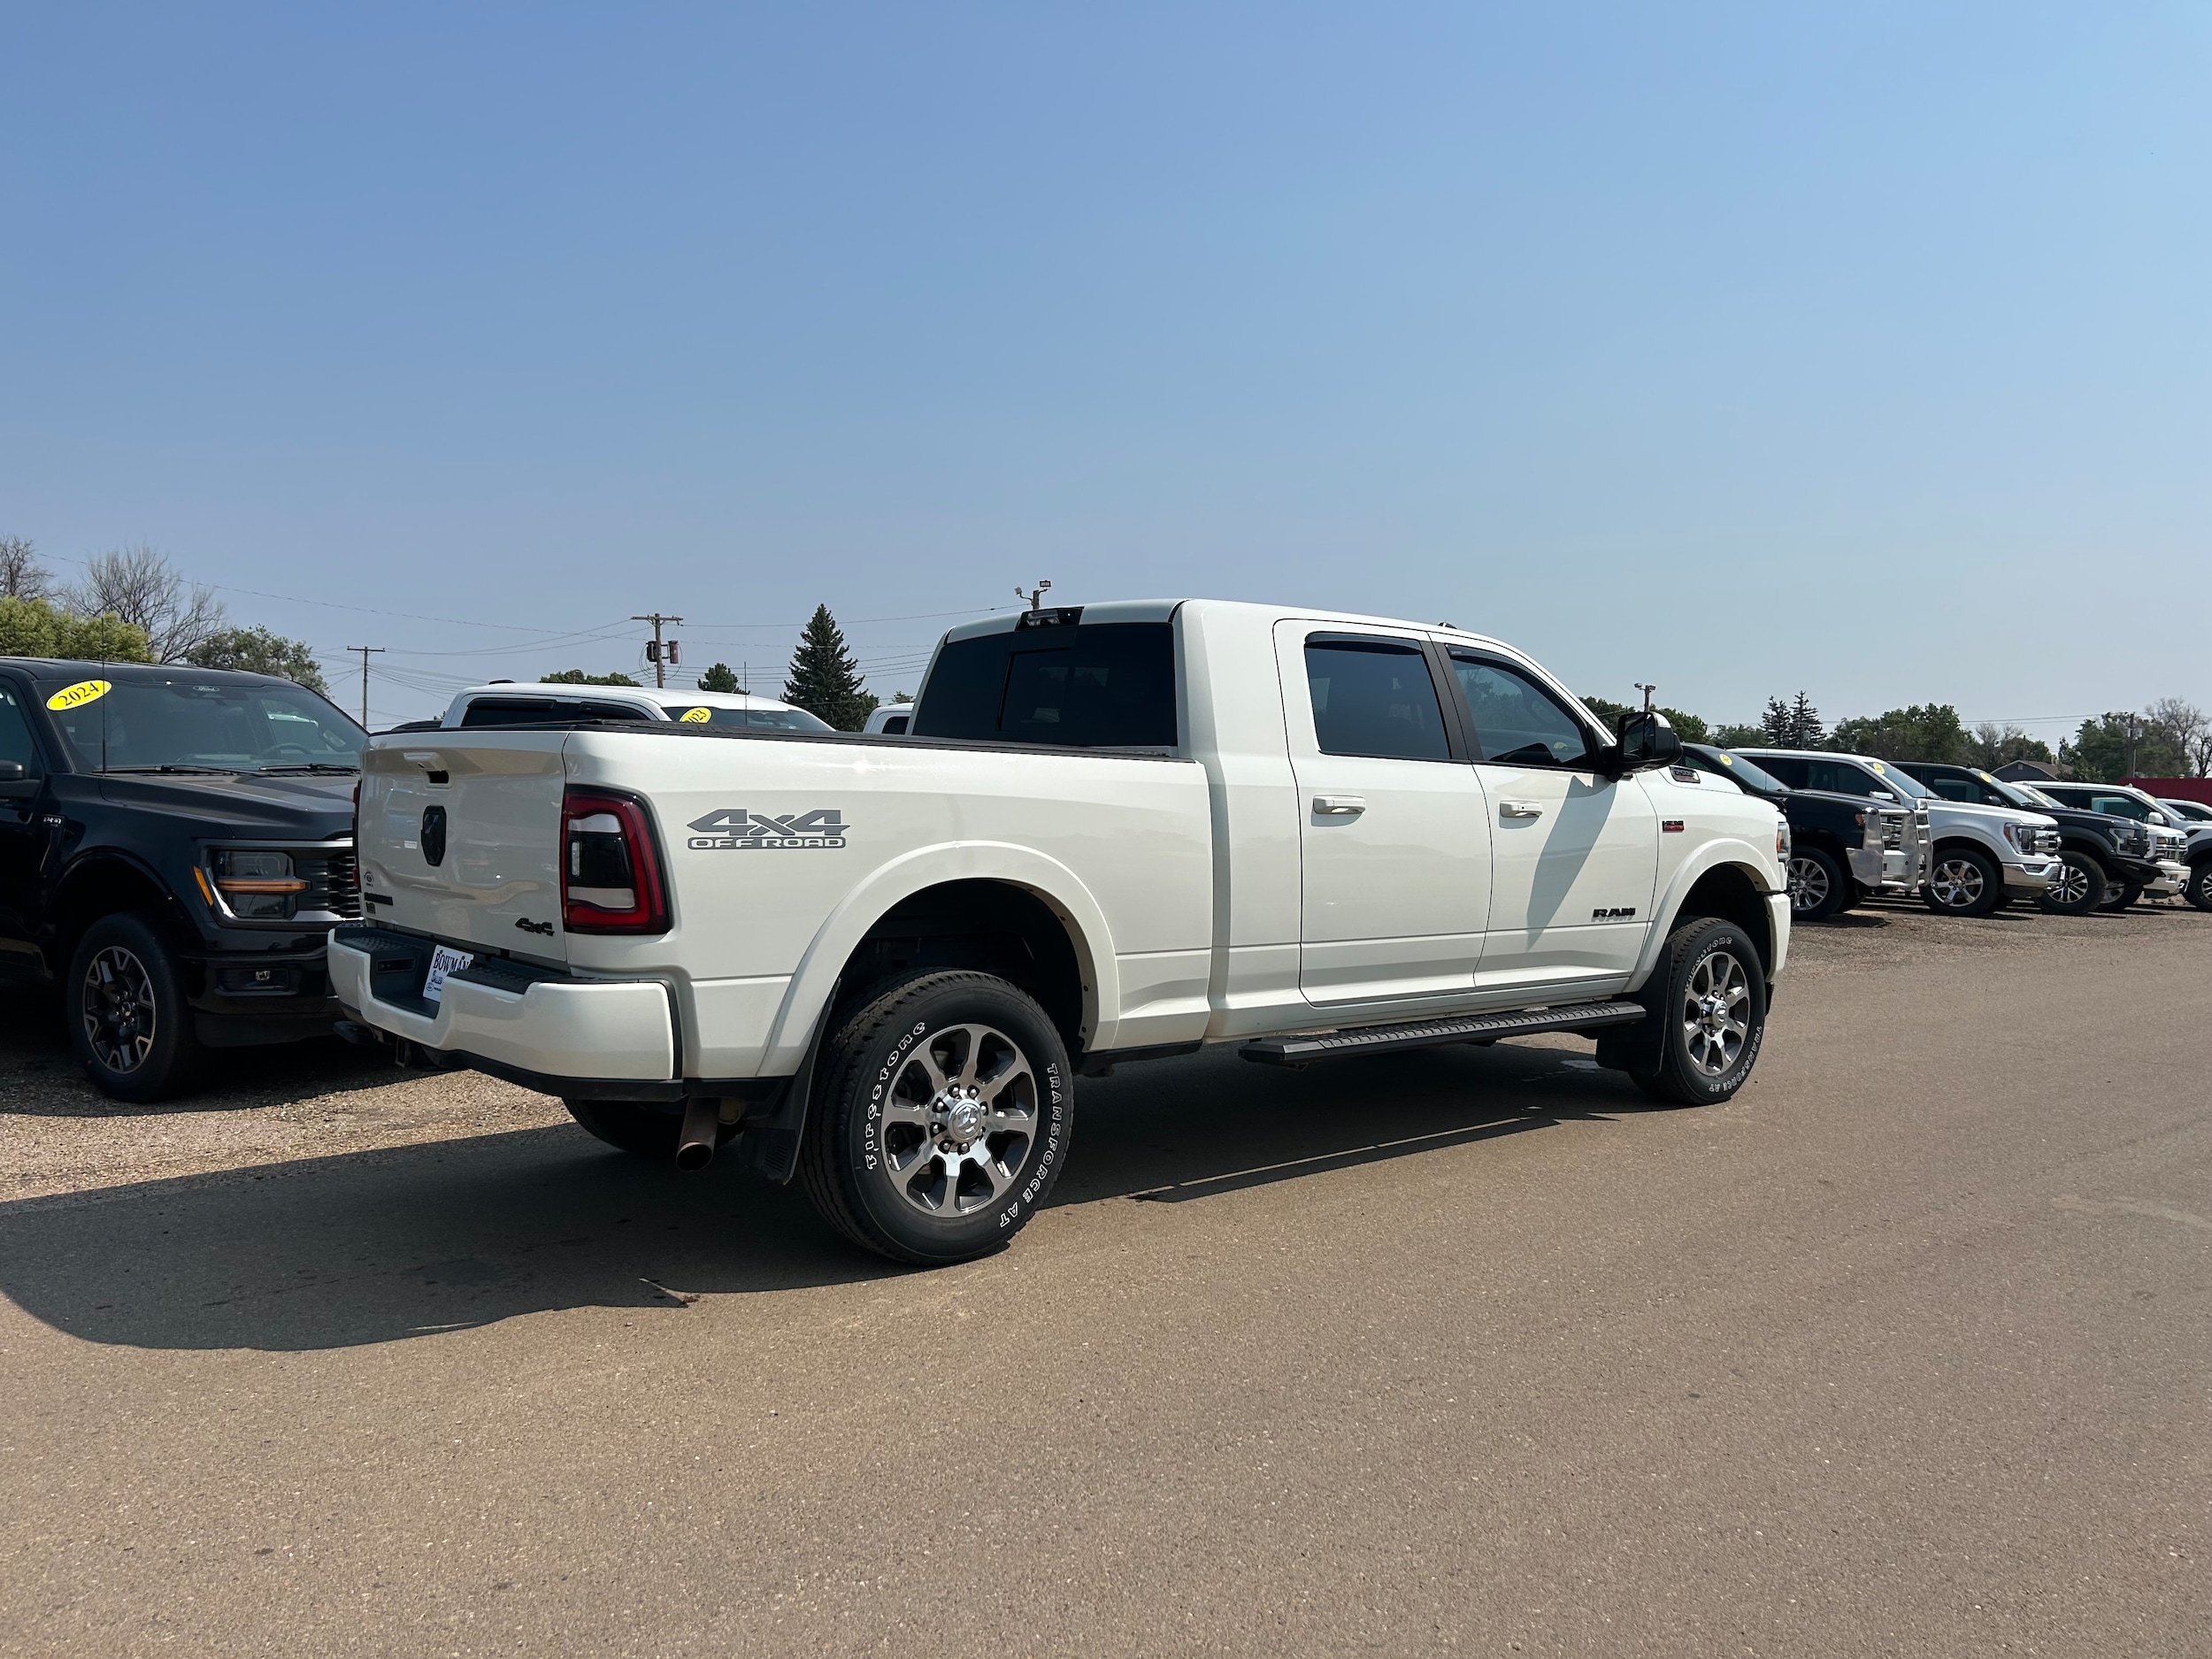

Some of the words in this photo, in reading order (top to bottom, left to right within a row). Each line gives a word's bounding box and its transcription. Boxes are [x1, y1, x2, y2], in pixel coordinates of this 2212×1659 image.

[58, 682, 99, 706] 2024
[691, 838, 754, 848] OFF
[761, 838, 843, 848] ROAD
[1593, 908, 1636, 918] RAM
[434, 952, 470, 972] BOWMAN
[1724, 1025, 1763, 1091] TRANSFORCE
[1709, 1082, 1721, 1092] AT
[1022, 1063, 1063, 1203] TRANSFORCE
[999, 1202, 1018, 1228] AT
